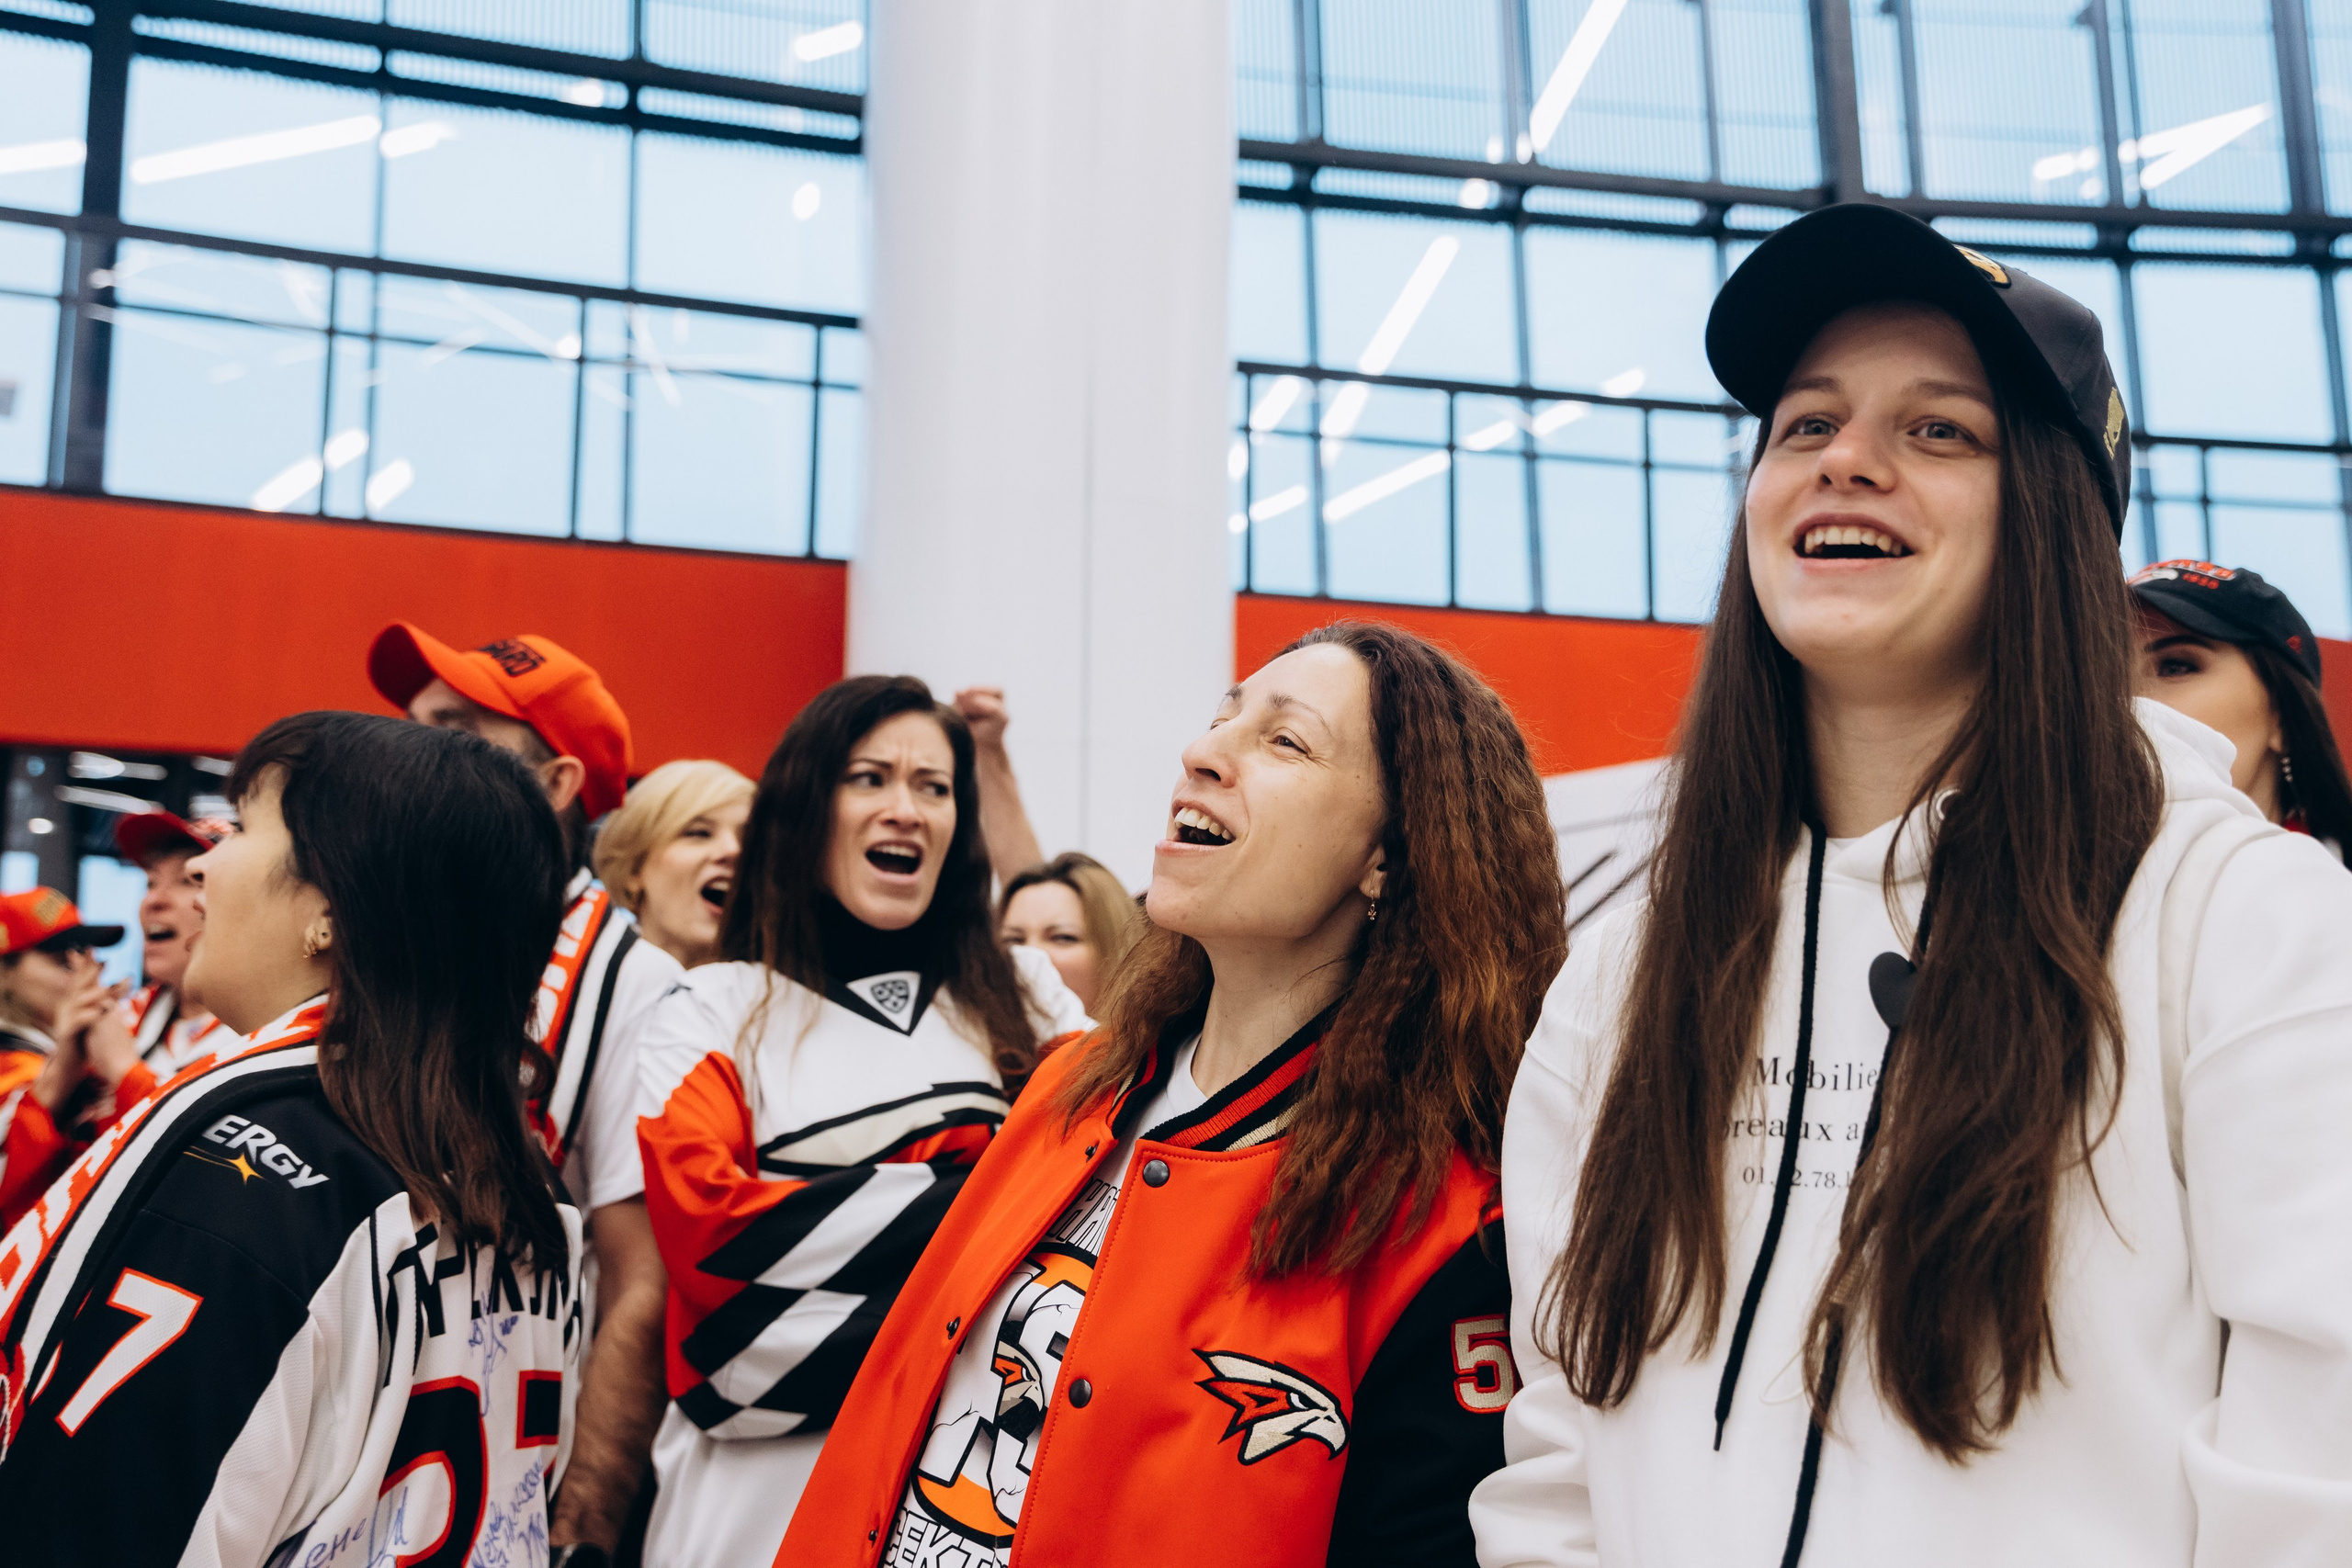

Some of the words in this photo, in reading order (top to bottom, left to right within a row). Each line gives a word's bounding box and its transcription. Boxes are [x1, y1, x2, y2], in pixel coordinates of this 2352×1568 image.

[200, 1114, 330, 1190] ERGY
[1725, 1117, 1833, 1142] reaux
[55, 1267, 204, 1438] 7
